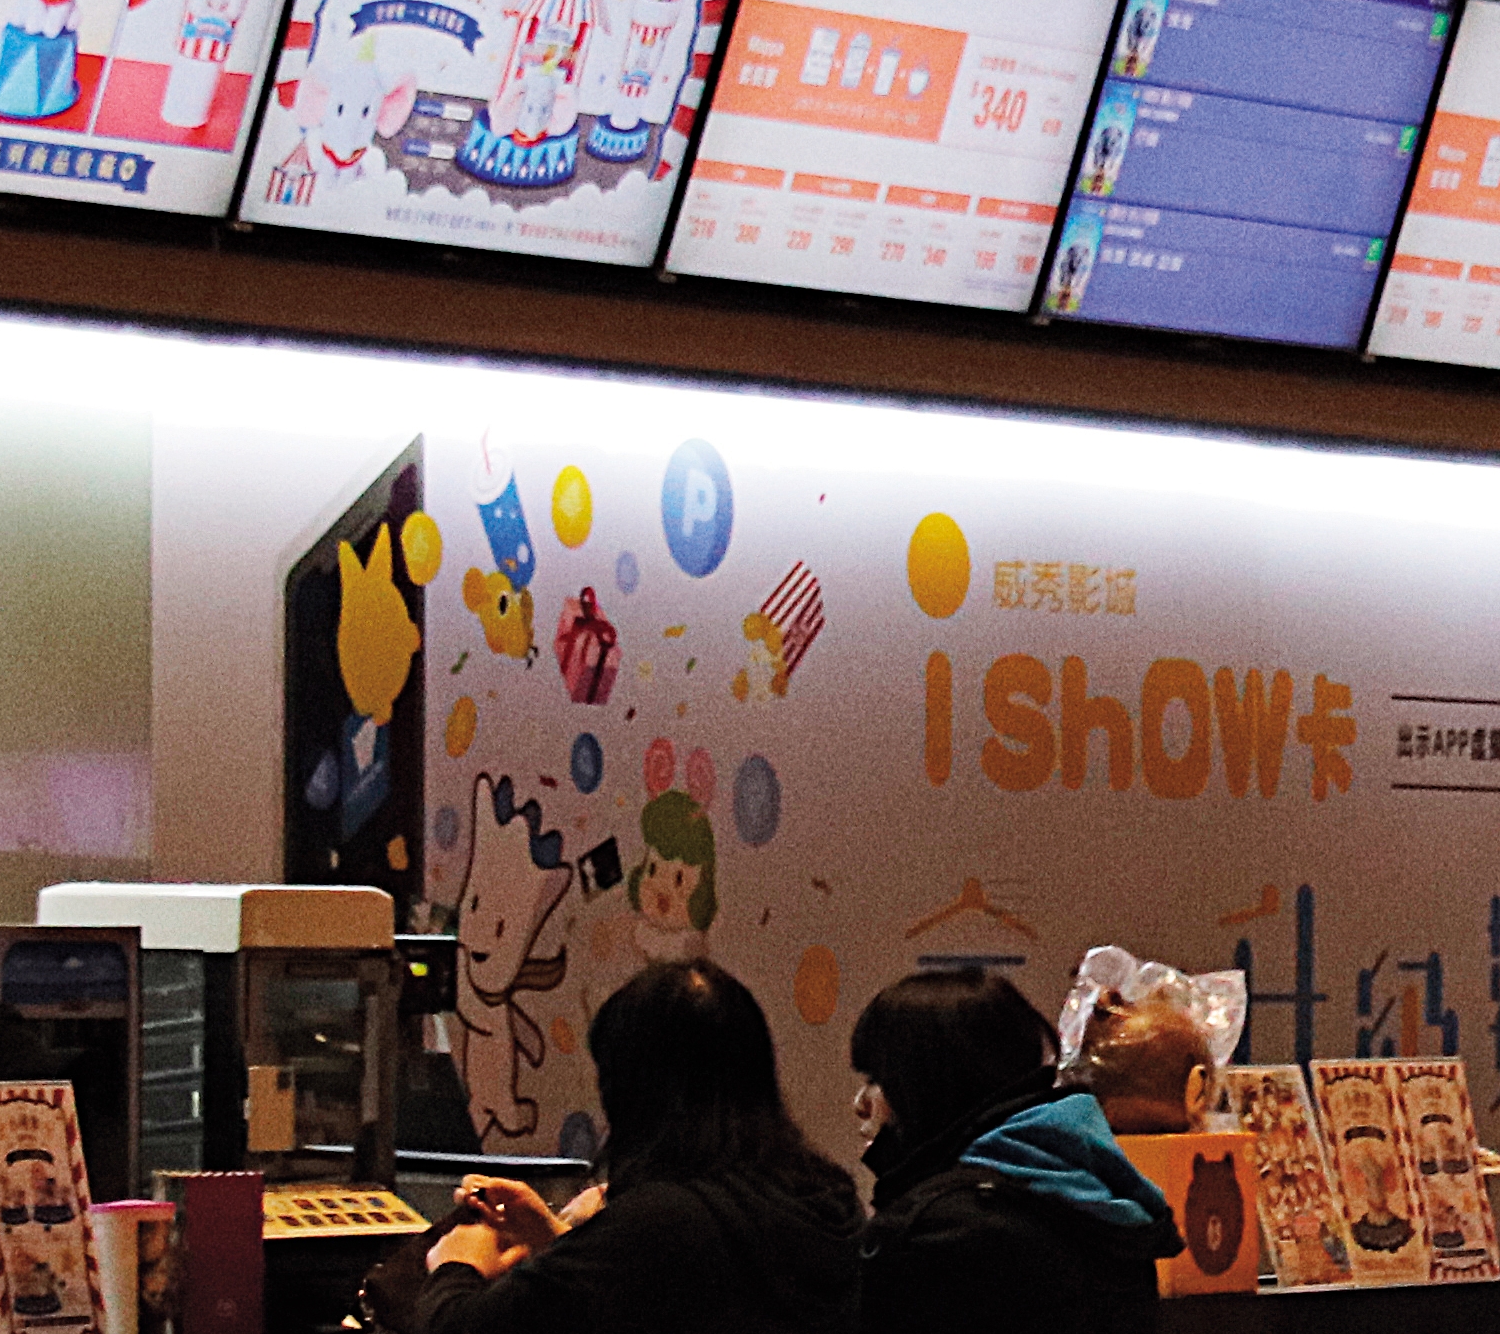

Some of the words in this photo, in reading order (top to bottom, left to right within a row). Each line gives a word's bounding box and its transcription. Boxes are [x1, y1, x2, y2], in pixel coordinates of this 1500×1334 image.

[971, 81, 1027, 132] $340
[993, 560, 1137, 616] 威秀影城
